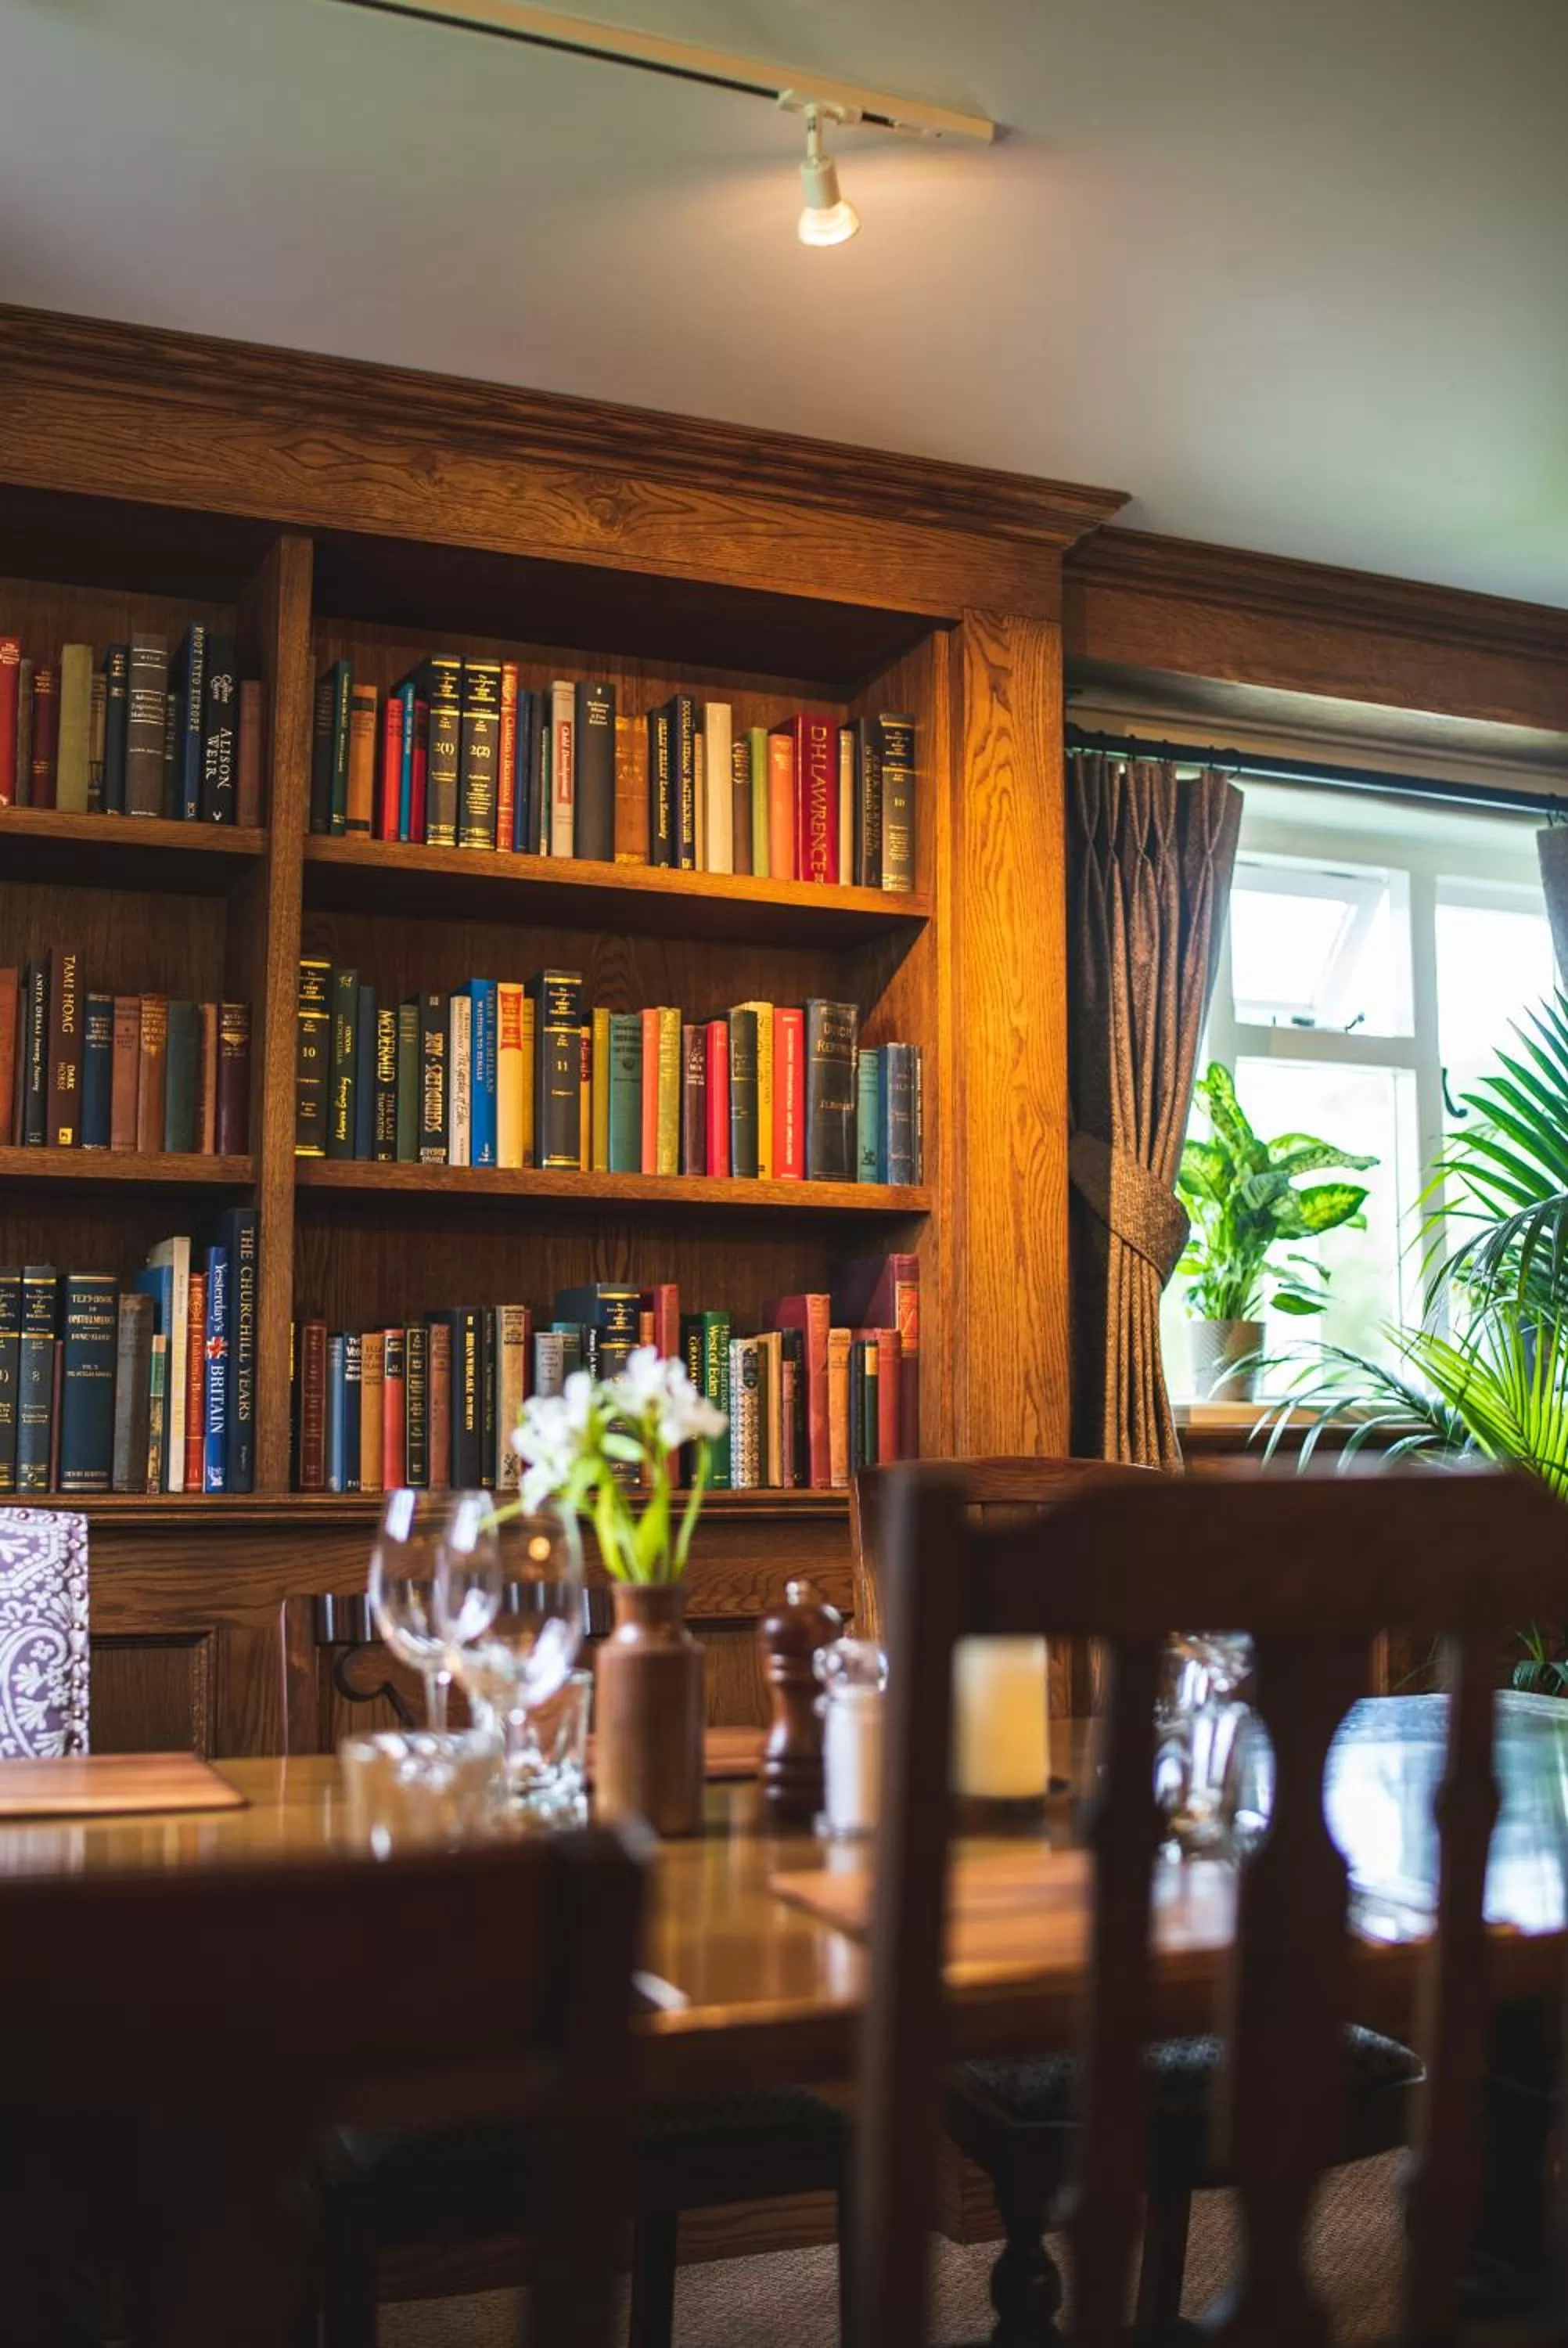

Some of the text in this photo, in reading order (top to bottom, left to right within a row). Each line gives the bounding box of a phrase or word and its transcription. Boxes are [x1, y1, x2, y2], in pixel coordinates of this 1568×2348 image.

[192, 659, 203, 686] INTO
[189, 688, 201, 733] EUROPE
[682, 700, 692, 739] DOUGLAS
[205, 735, 221, 781] WEIR
[217, 727, 233, 790] ALISON
[469, 744, 491, 758] 2(2)
[809, 763, 828, 872] LAWRENCE
[34, 973, 44, 1003] ANITA
[62, 954, 77, 1033] TAMI HOAG
[302, 1046, 317, 1058] 10
[556, 1061, 569, 1072] 11
[67, 1064, 76, 1090] DARK
[210, 1262, 228, 1333] Yesterday's
[237, 1226, 254, 1421] THE CHURCHILL YEARS
[707, 1324, 720, 1397] West of Eden
[717, 1324, 731, 1413] Harry Harrison
[210, 1364, 225, 1434] BRITAIN
